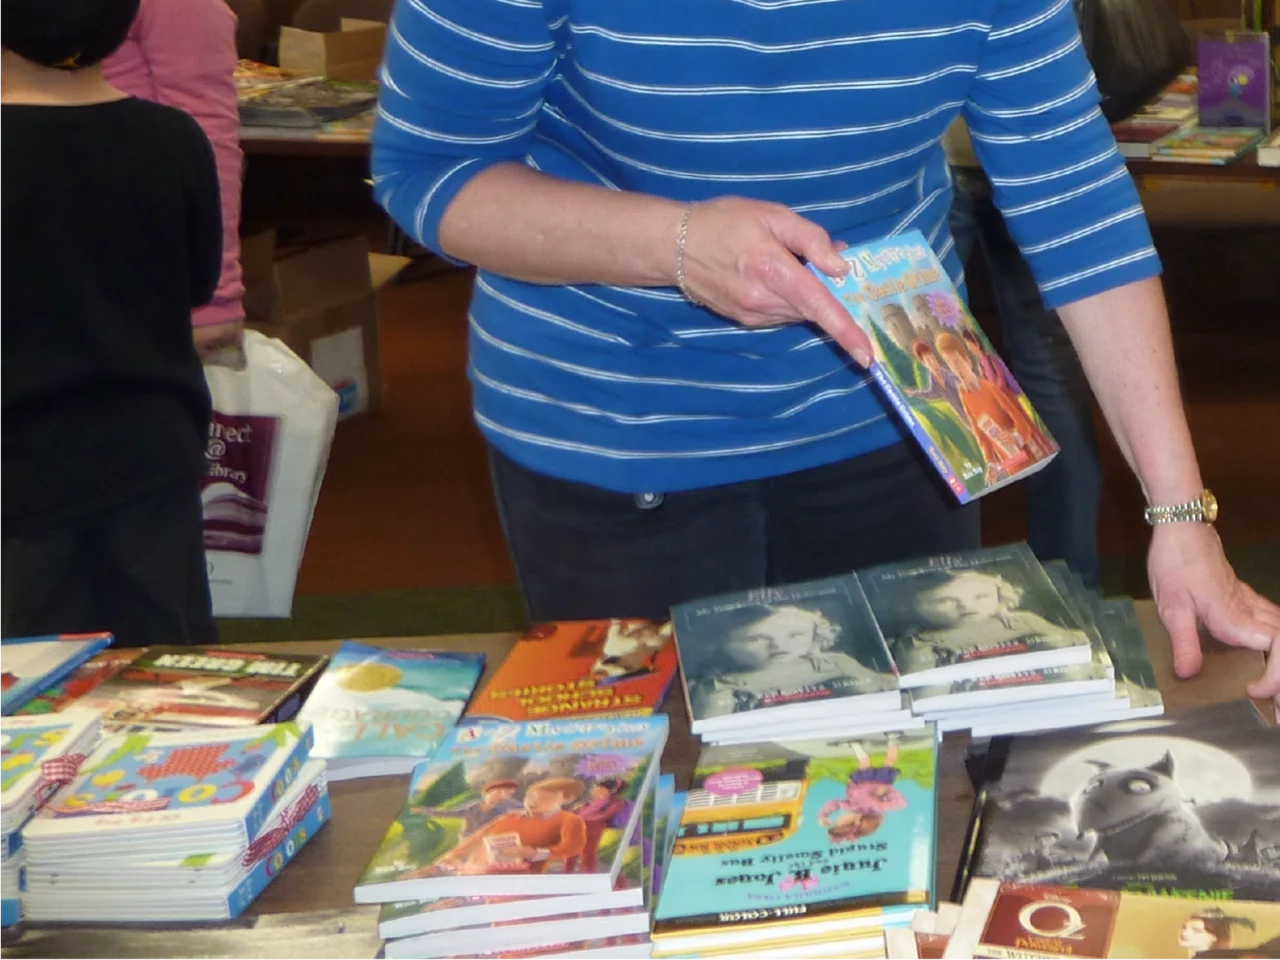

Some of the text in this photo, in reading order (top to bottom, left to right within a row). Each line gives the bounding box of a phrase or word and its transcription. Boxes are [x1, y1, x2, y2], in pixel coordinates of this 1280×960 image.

[354, 720, 447, 740] CALL
[720, 841, 889, 868] Stupid Smelly Bus
[820, 856, 889, 877] Junie
[714, 872, 782, 888] Jones
[718, 903, 808, 923] FULL-COLOR
